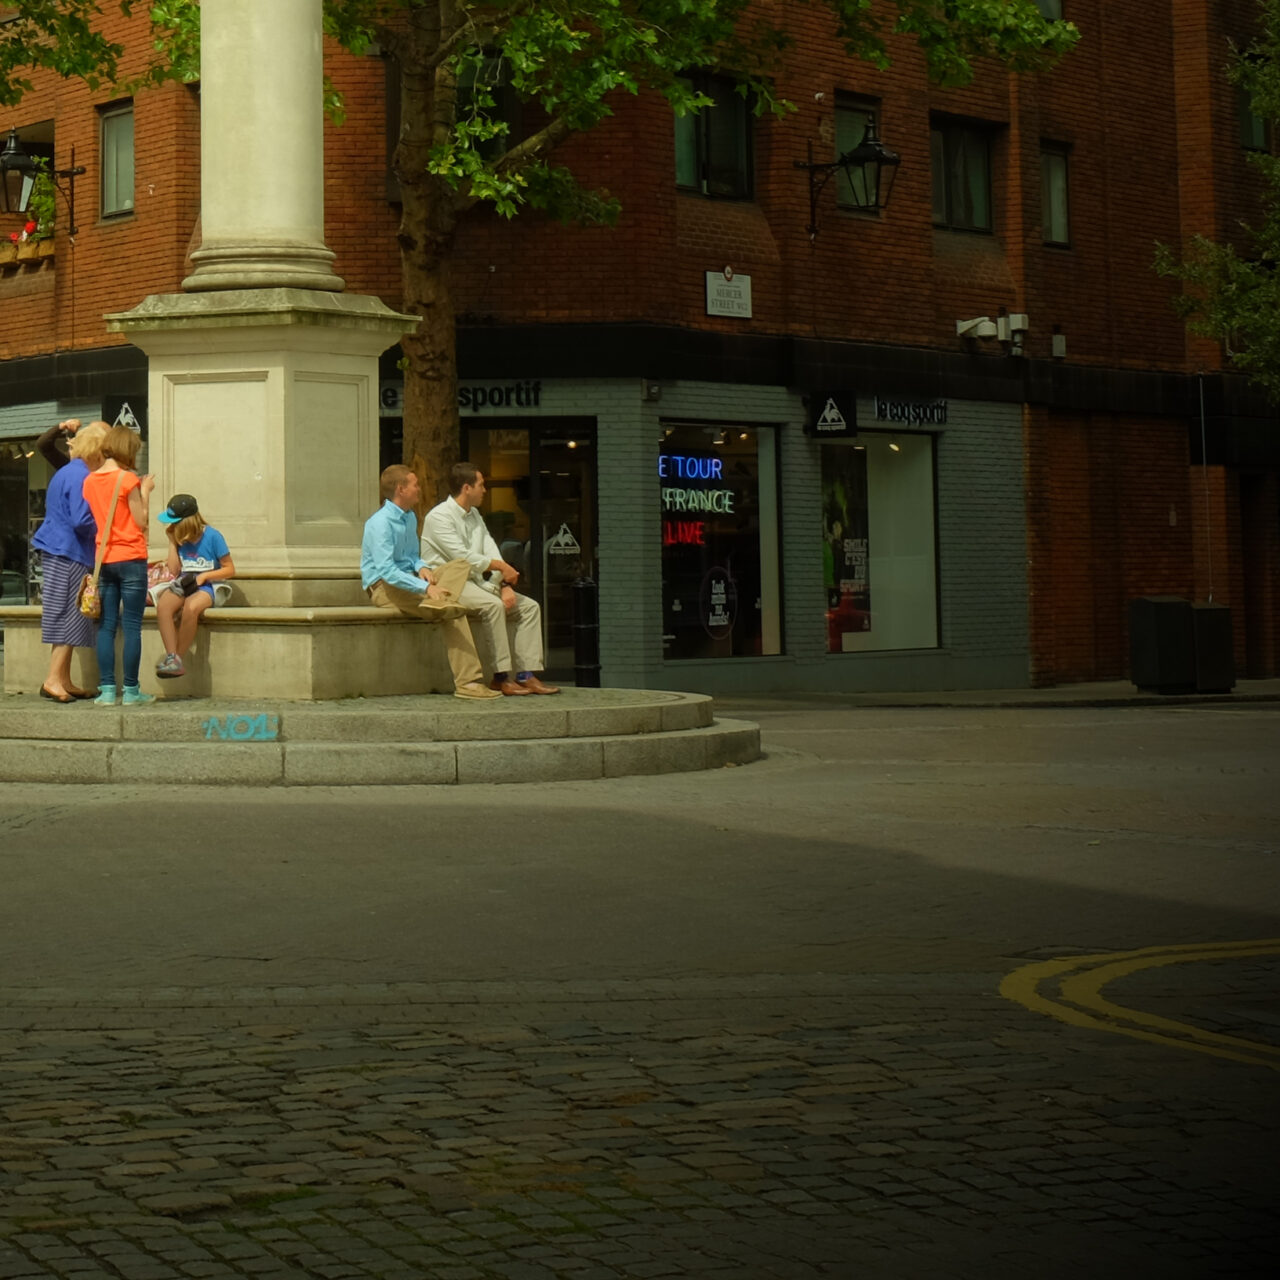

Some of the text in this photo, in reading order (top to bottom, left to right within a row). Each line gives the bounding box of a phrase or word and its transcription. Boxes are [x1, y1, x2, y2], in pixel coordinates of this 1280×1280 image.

[711, 298, 735, 309] STREET
[716, 289, 742, 299] MERCER
[458, 381, 542, 412] sportif
[874, 395, 948, 426] le coq sportif
[672, 456, 723, 480] TOUR
[663, 487, 735, 513] FRANCE
[664, 520, 705, 546] LIVE
